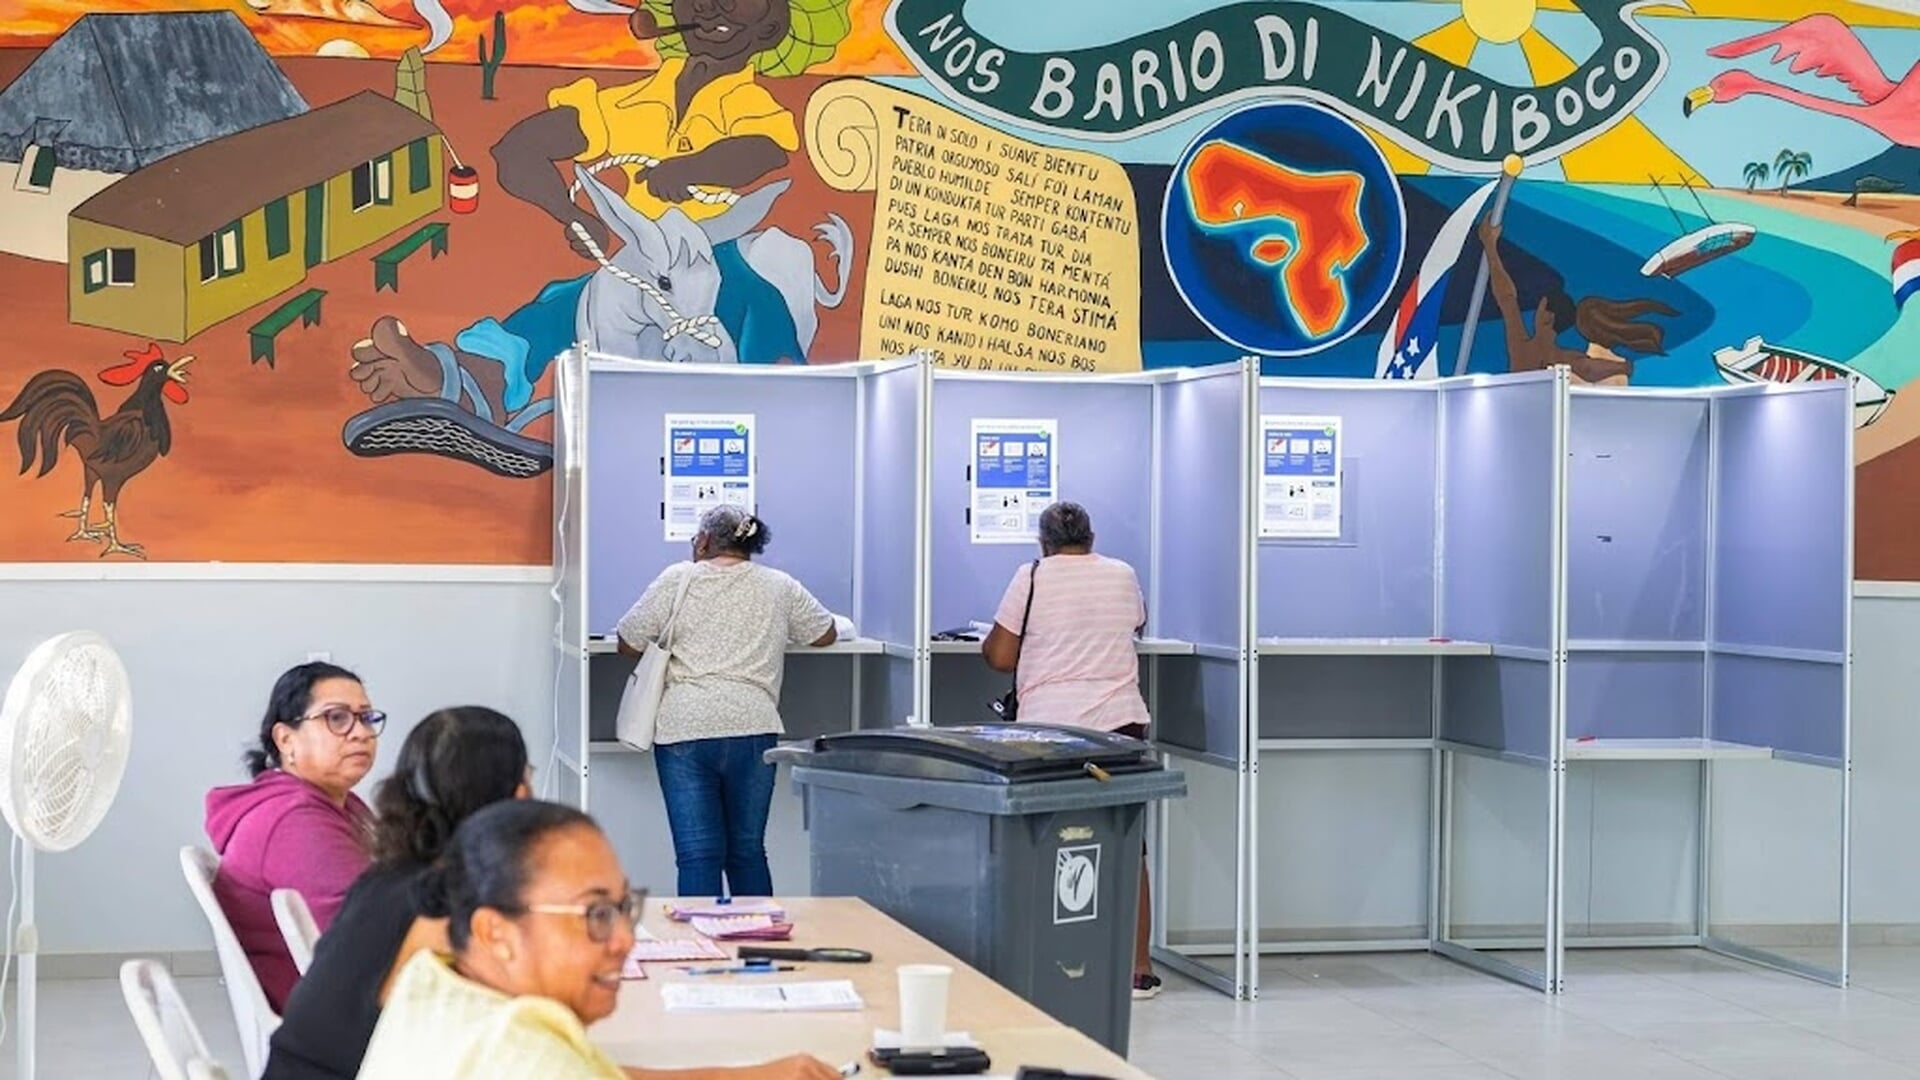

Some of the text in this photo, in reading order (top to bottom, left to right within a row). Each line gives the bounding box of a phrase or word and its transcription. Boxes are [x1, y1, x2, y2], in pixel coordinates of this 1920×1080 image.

[917, 13, 1641, 154] NOS BARIO DI NIKIBOCO
[892, 105, 931, 136] TERA
[937, 125, 947, 140] DI
[950, 128, 978, 149] SOLO
[999, 143, 1040, 168] SUAVE
[1043, 153, 1100, 182] BIENTU
[895, 134, 935, 160] PATRIA
[941, 149, 1000, 177] ORGUYOSO
[1073, 186, 1124, 212] LAMAN
[888, 198, 1092, 266] PUES LAGA NOS TRATA TUR DIA
[889, 175, 902, 191] DI
[905, 179, 921, 197] UN
[985, 201, 1007, 220] TUR
[1010, 209, 1045, 232] PARTI
[1051, 220, 1090, 244] GABÁ
[891, 155, 1132, 236] PUEBLO HUMILDE SEMPER KONTENTU
[885, 235, 1111, 310] PA NOS KANTA DEN BON HARMONIA
[888, 217, 1112, 290] PA SEMPER NOS BONEIRU TA MENTÁ
[879, 288, 1107, 354] LAGA NOS TUR KOMO BONERIANO
[884, 257, 1119, 331] DUSHI BONEIRU, NOS TERA STIMÁ
[878, 314, 901, 331] UNI
[903, 319, 931, 341] NOS
[986, 336, 1034, 360] HALSA
[1038, 348, 1067, 366] NOS
[1070, 354, 1096, 373] BOS
[880, 338, 905, 356] NOS
